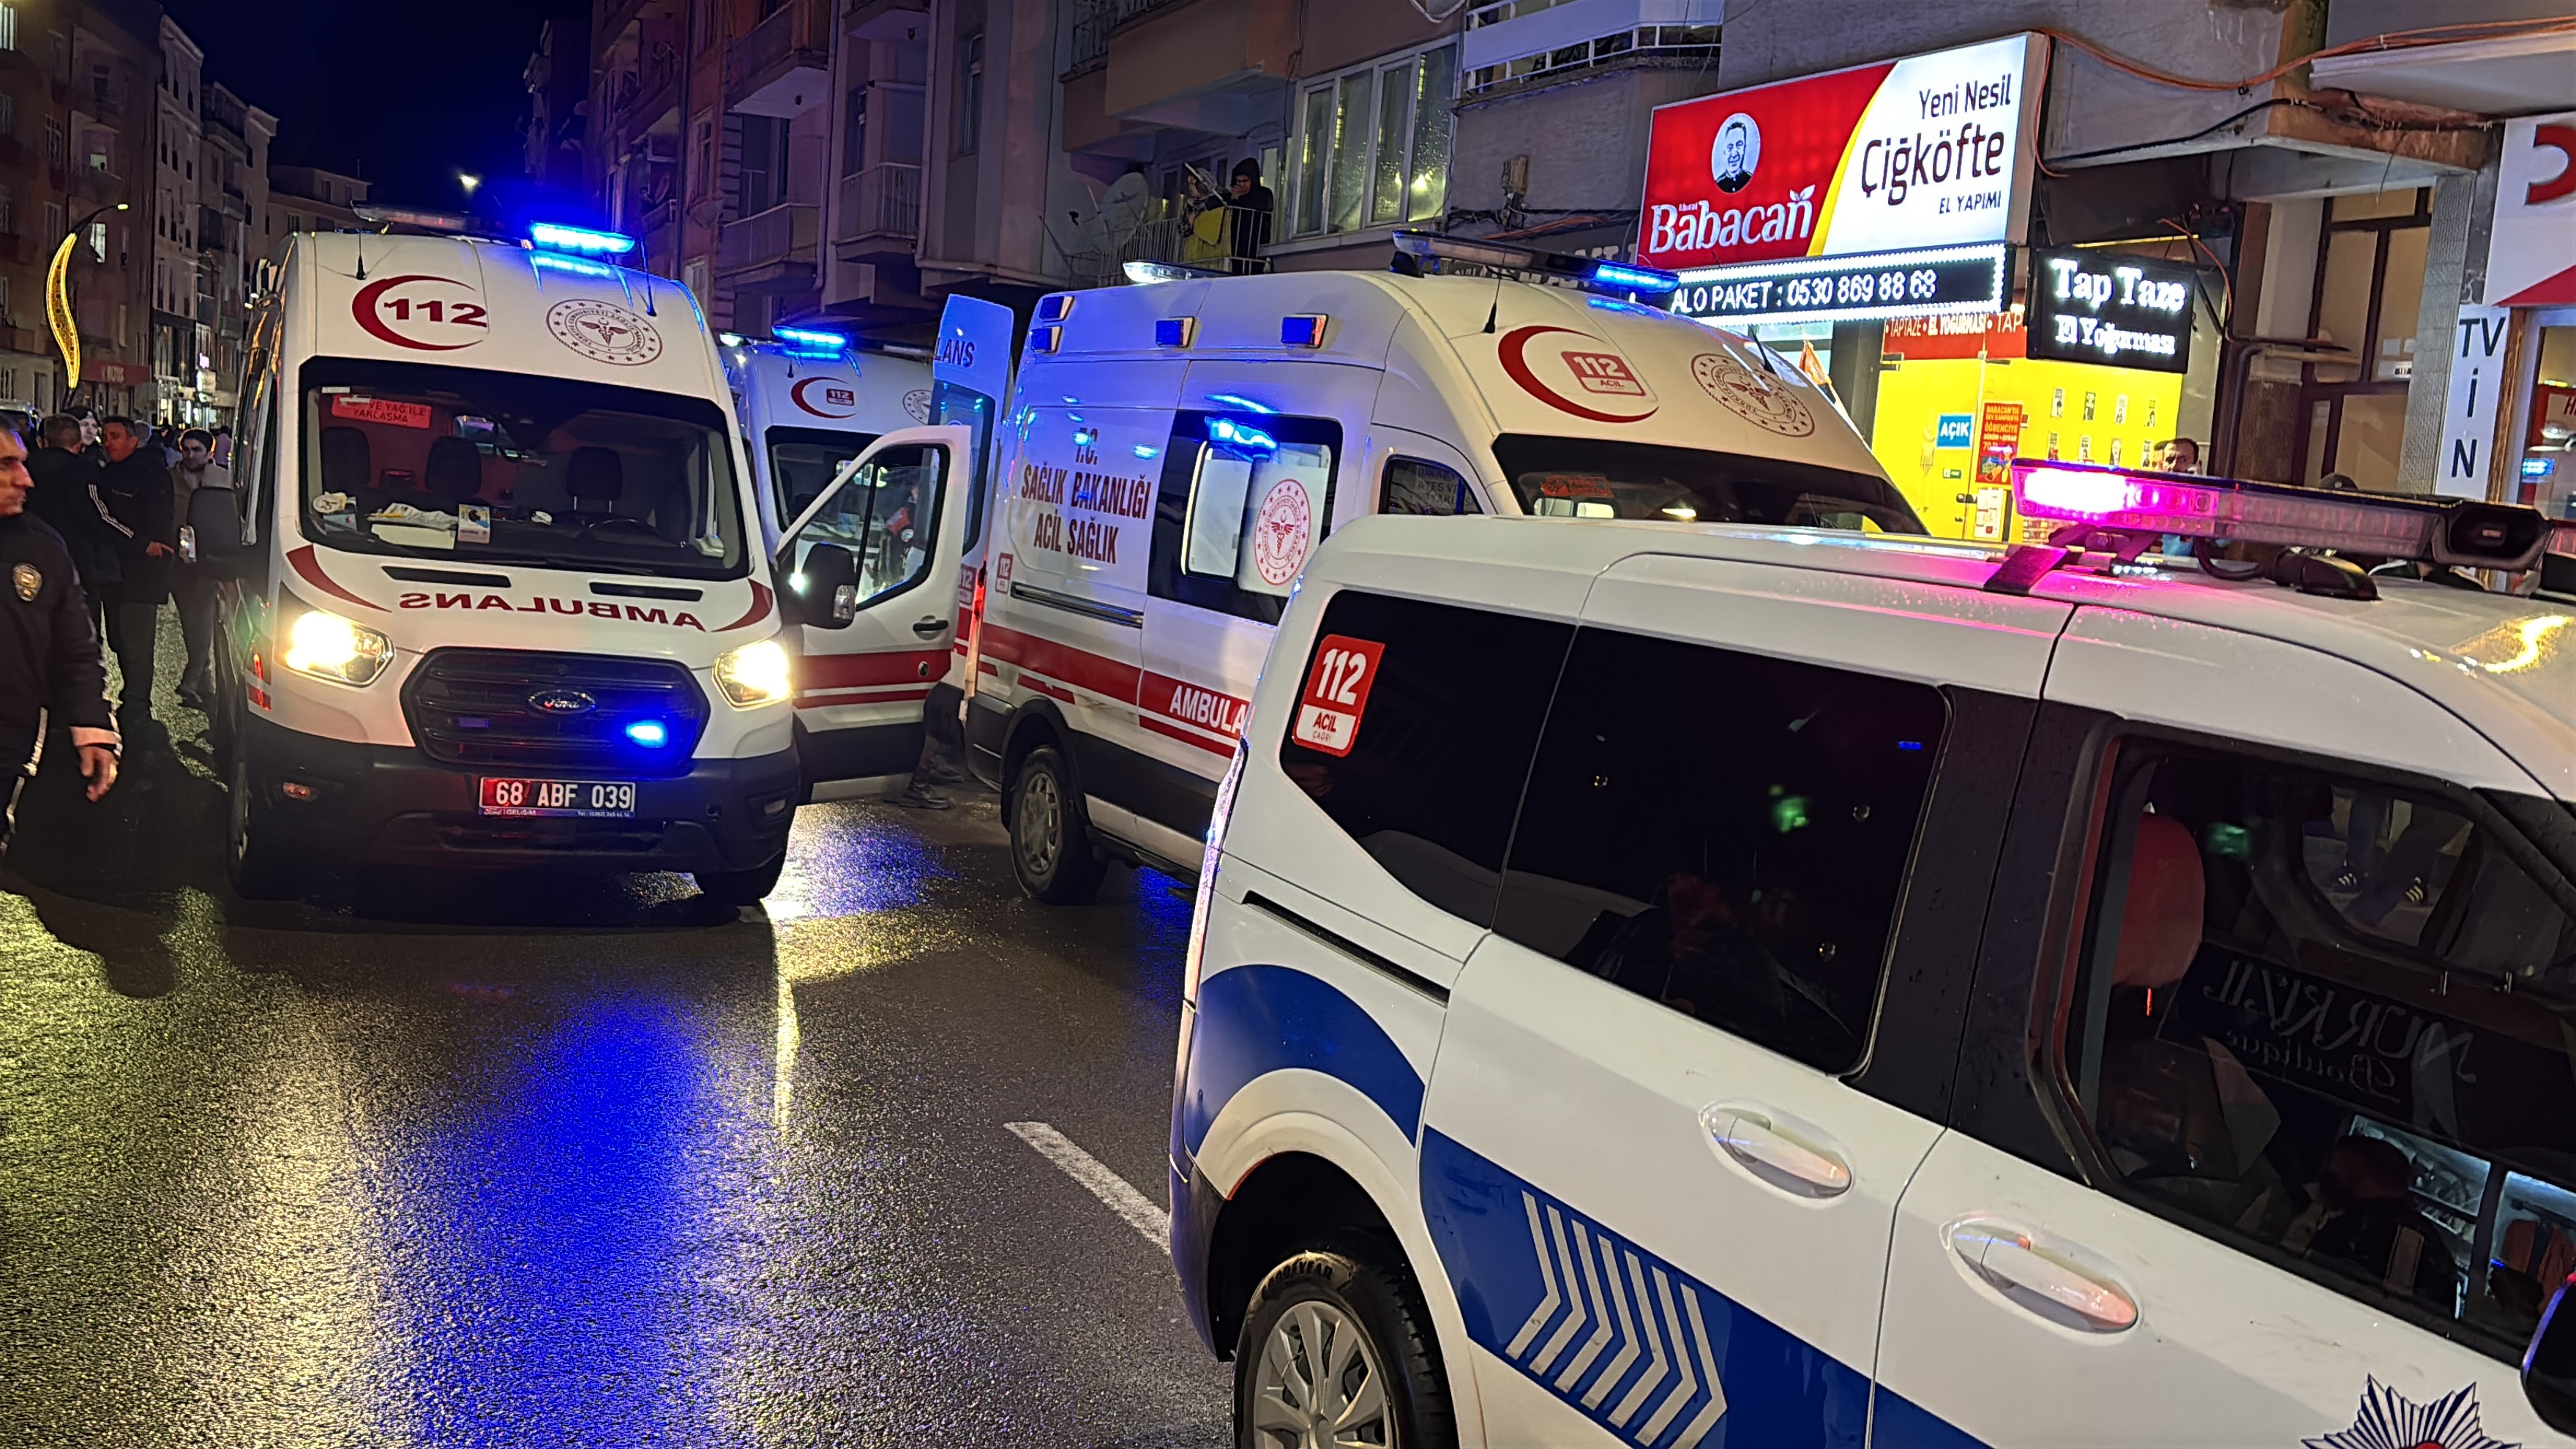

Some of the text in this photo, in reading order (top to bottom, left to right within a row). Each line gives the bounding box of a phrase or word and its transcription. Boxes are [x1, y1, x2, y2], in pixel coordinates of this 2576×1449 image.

[1919, 73, 2011, 119] Yeni Nesil
[1862, 122, 2004, 206] Çiğköfte
[1939, 190, 2002, 214] EL YAPIMI
[1649, 198, 1813, 254] Babacan
[1670, 286, 1707, 314] ALO
[1711, 281, 1773, 311] PAKET
[1786, 277, 1833, 306] 0530
[1838, 274, 1874, 303] 869
[1879, 271, 1906, 300] 88
[2051, 258, 2187, 312] Tap Taze
[383, 299, 487, 328] 112
[2459, 316, 2506, 359] TV
[1573, 356, 1625, 378] 112
[829, 390, 850, 399] 112
[1940, 422, 1969, 440] AÇIK
[1021, 460, 1151, 520] SAĞLIK BAKANLIĞI
[1033, 509, 1119, 564] ACİL SAĞLIK
[1316, 648, 1366, 705] 112
[1312, 731, 1333, 743] ÇAĞRI
[1313, 712, 1336, 733] ACİL
[495, 782, 632, 808] 68 ABF 039
